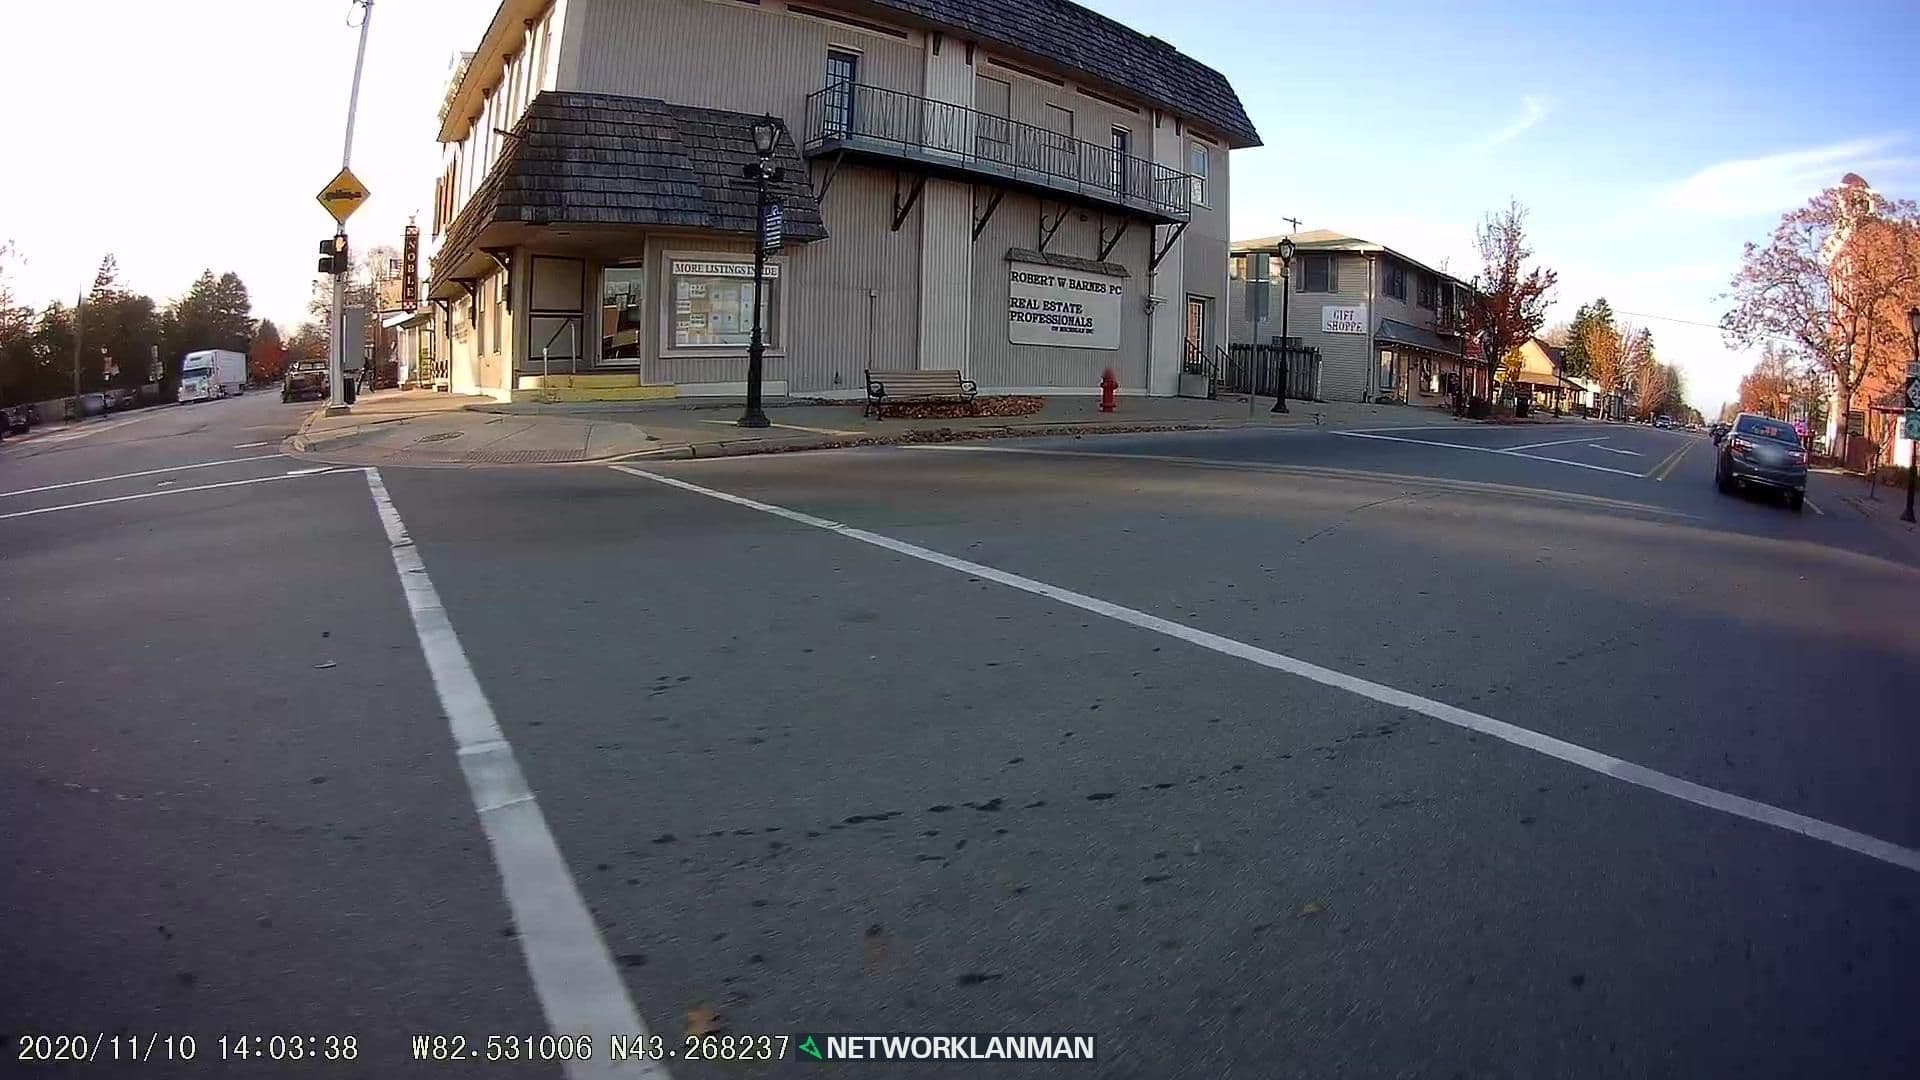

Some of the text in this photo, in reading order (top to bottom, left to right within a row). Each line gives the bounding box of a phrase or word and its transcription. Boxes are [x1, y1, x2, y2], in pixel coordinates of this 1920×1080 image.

[406, 238, 417, 297] NOBLE
[675, 264, 704, 273] MORE
[705, 264, 746, 275] LISTINGS
[1011, 271, 1123, 295] ROBERT W BARNES PC
[1010, 297, 1083, 314] REAL ESTATE
[1010, 310, 1094, 327] PROFESSIONALS
[1333, 310, 1354, 321] GIFT
[1326, 320, 1362, 332] SHOPPE
